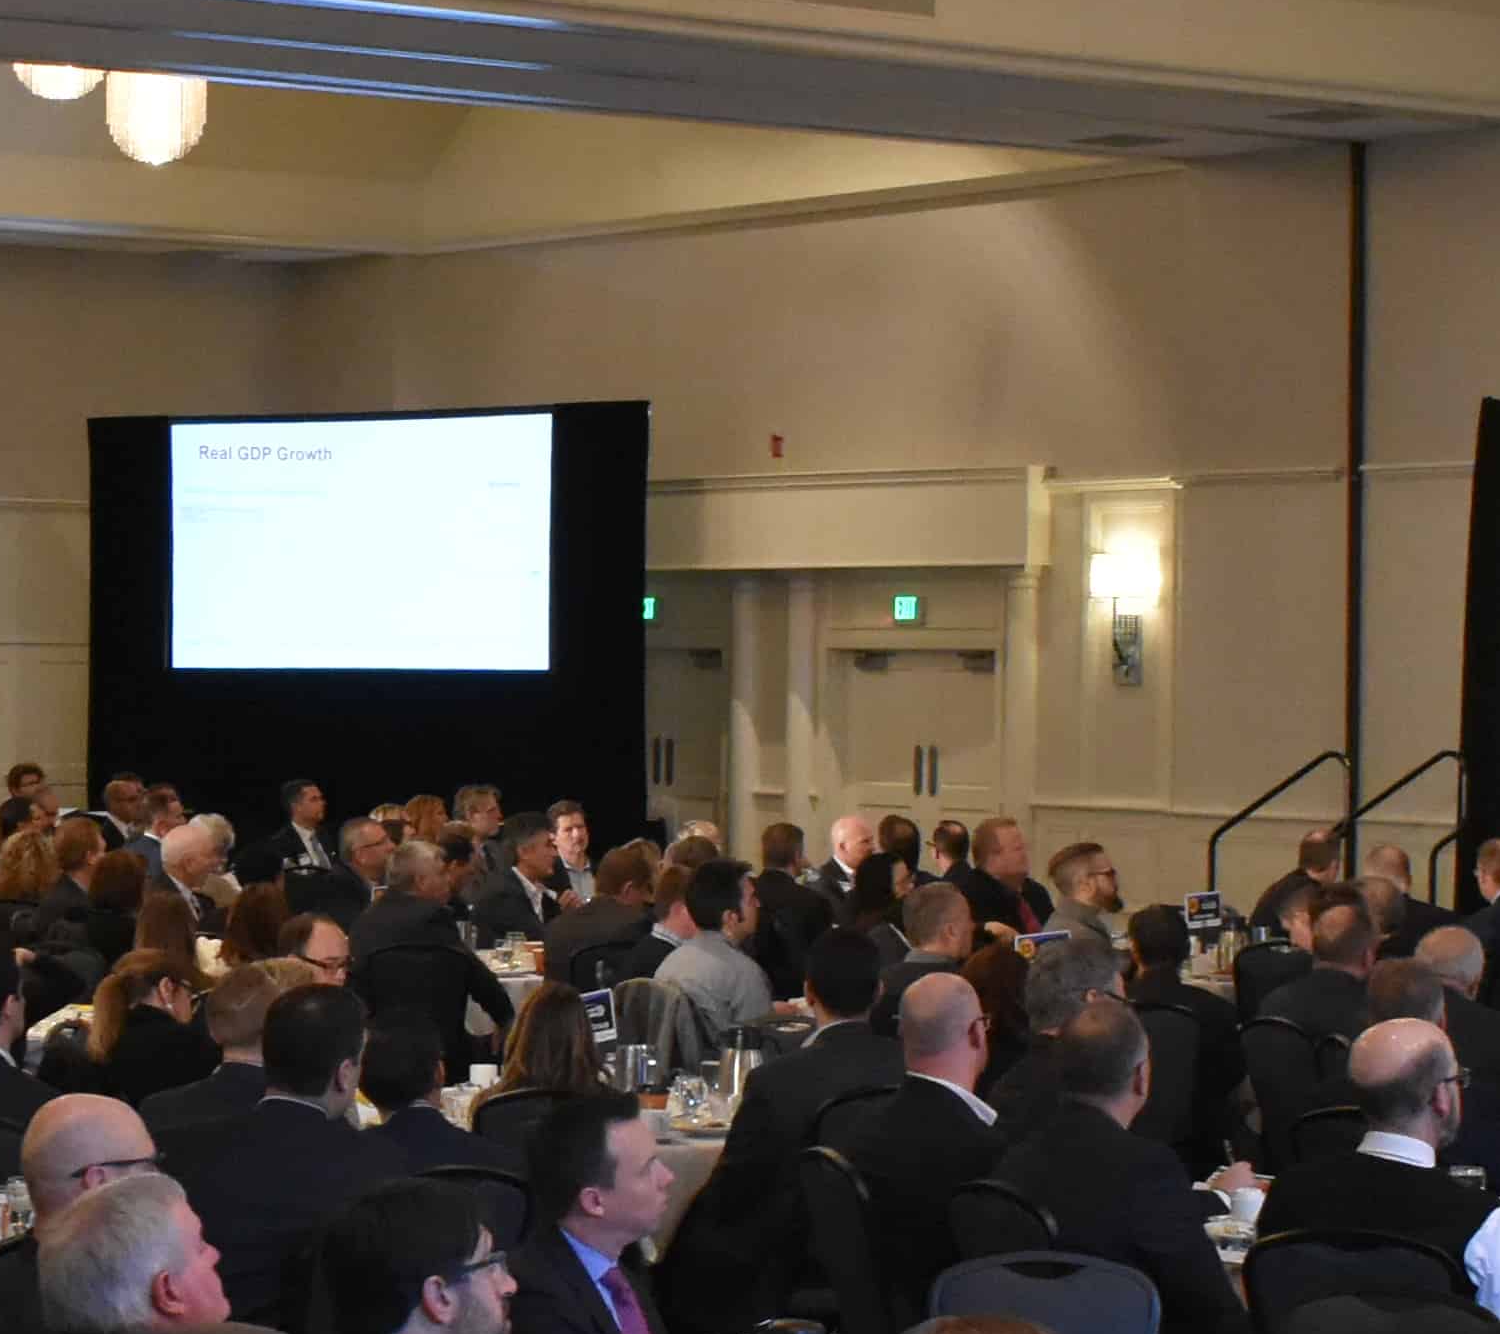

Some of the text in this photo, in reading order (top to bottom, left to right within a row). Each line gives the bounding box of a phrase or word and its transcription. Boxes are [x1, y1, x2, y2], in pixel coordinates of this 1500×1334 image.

[199, 445, 333, 461] Real GDP Growth
